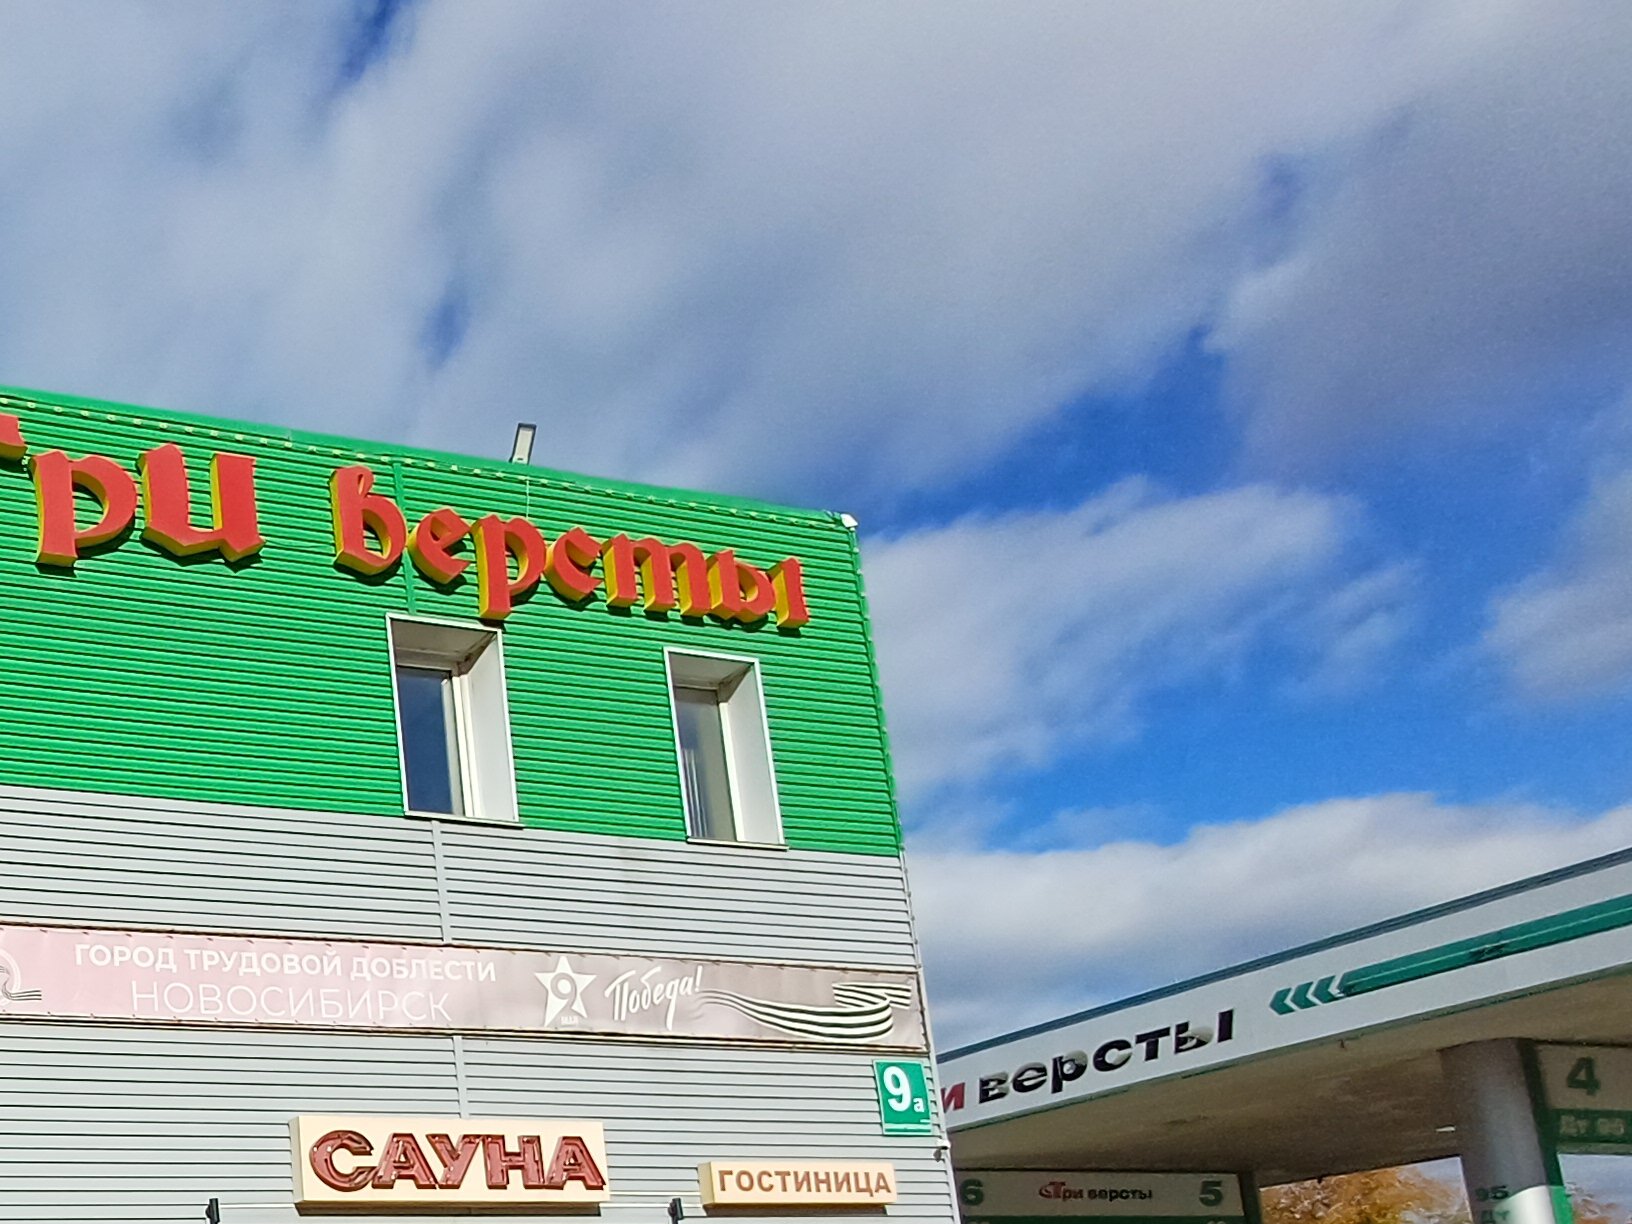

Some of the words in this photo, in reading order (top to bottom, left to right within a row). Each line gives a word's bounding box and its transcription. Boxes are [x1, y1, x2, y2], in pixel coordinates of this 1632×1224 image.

[329, 463, 812, 632] версты
[74, 943, 176, 973] ГОРОД
[183, 948, 343, 979] ТРУДОВОЙ
[349, 954, 497, 984] ДОБЛЕСТИ
[131, 979, 453, 1022] НОВОСИБИРСК
[604, 964, 704, 1031] Победа!
[978, 1008, 1235, 1104] версты
[1566, 1056, 1601, 1097] 4
[309, 1130, 606, 1192] САУНА
[718, 1169, 892, 1197] ГОСТИНИЦА
[959, 1178, 985, 1207] 6
[1199, 1180, 1223, 1207] 5
